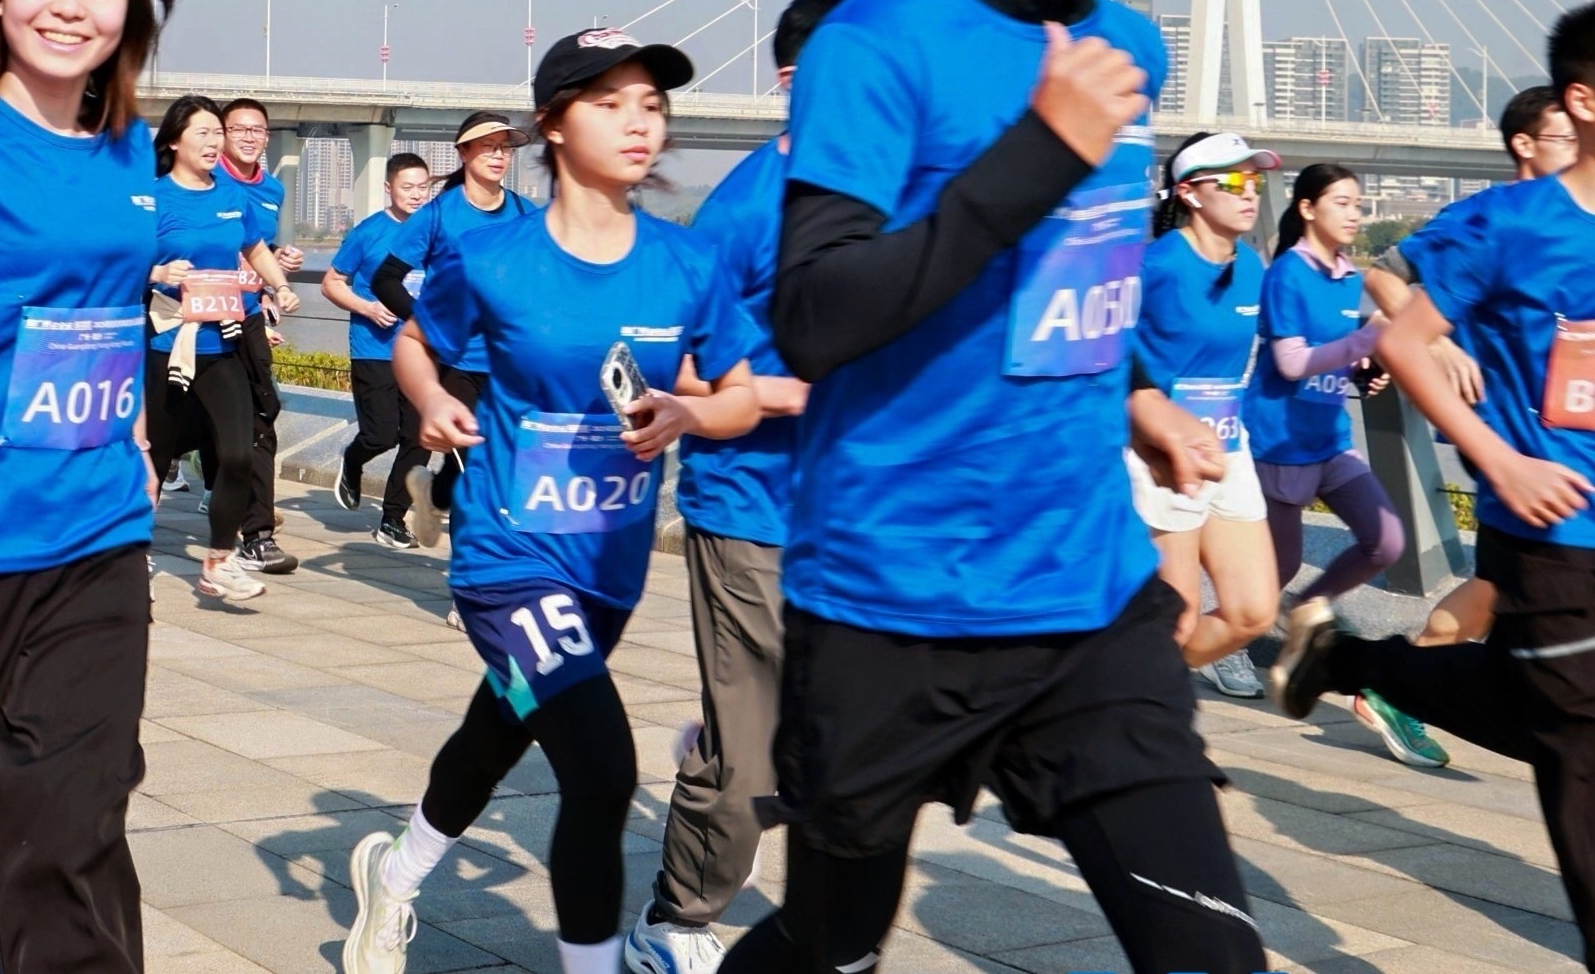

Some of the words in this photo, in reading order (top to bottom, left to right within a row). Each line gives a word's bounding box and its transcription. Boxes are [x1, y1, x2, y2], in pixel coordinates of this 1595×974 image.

[190, 296, 240, 314] B212
[21, 376, 135, 424] A016
[1305, 374, 1350, 395] A09
[524, 471, 652, 512] A020
[510, 593, 595, 676] 15
